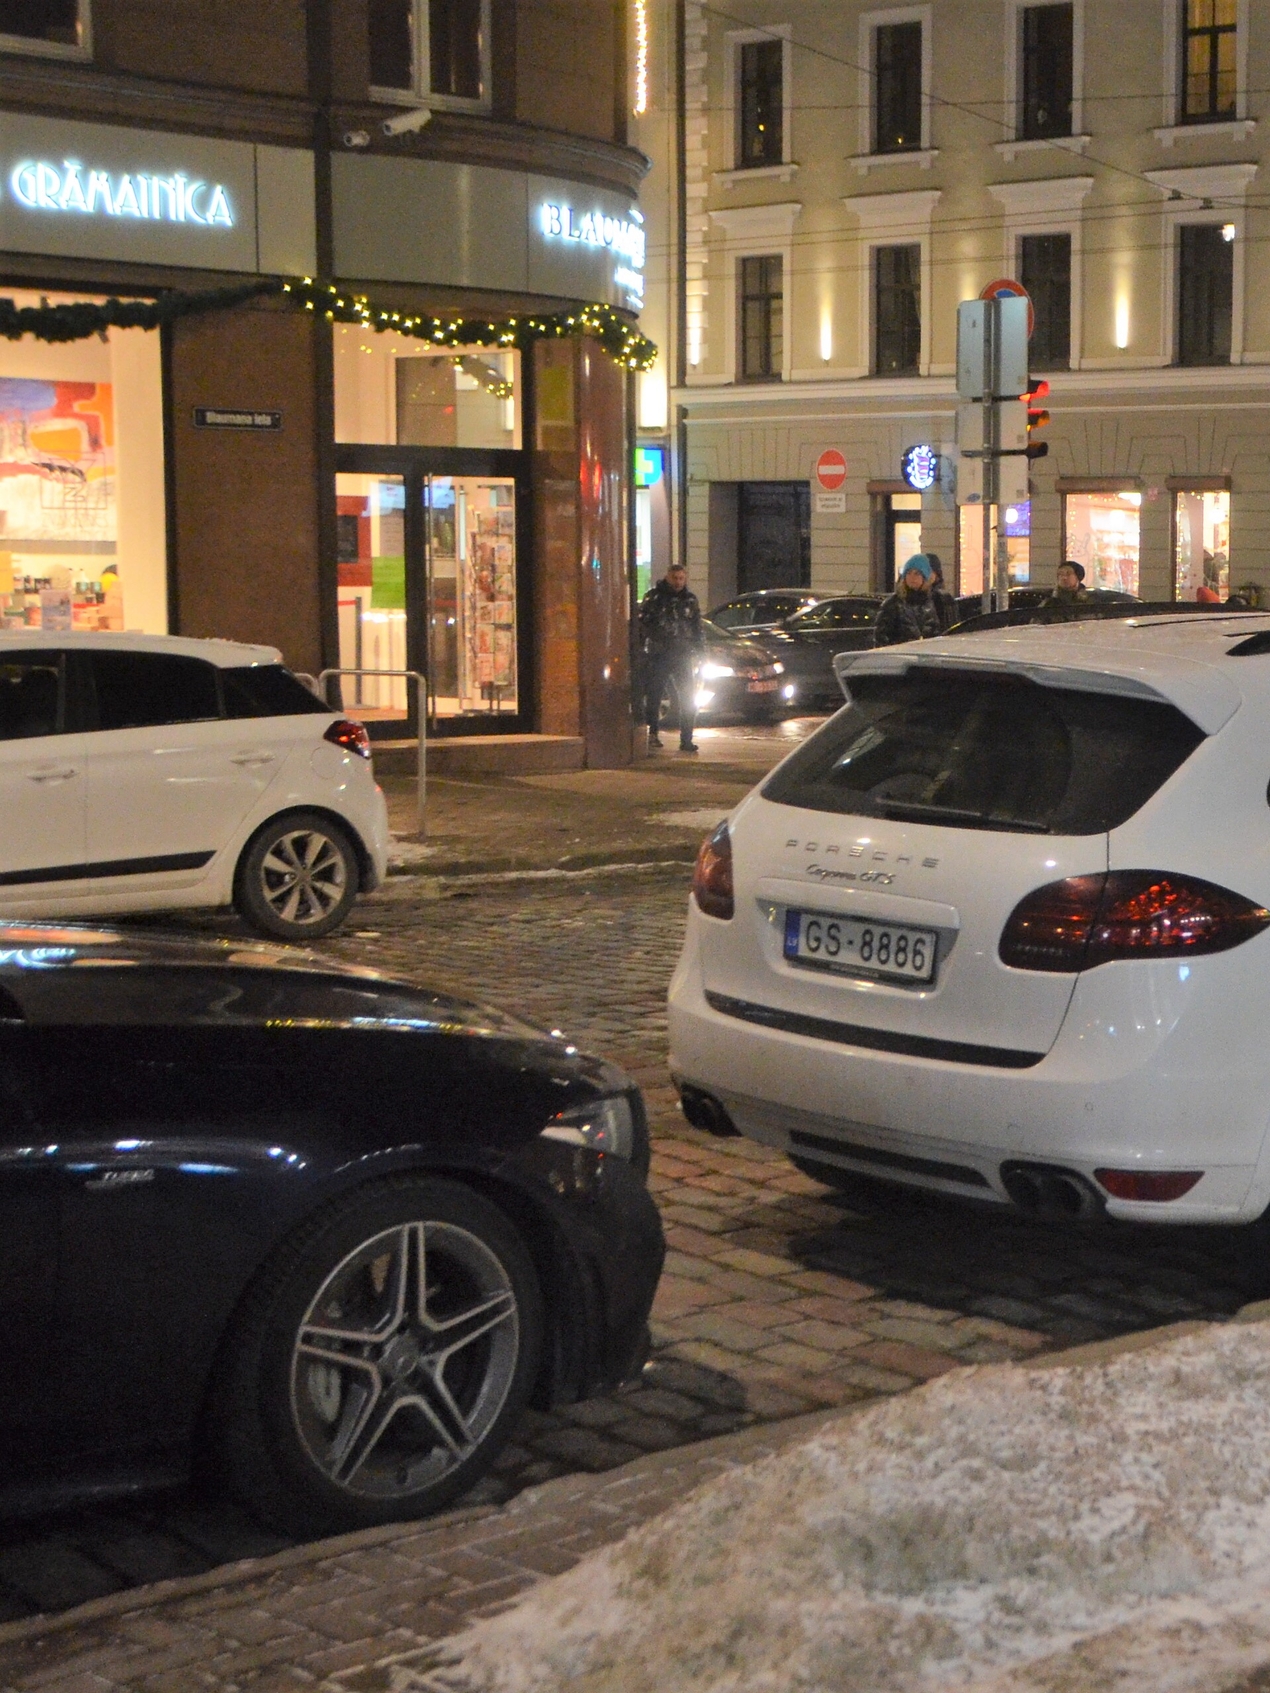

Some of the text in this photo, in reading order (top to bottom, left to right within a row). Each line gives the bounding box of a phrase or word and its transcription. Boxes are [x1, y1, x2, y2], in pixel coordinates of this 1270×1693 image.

[12, 160, 233, 226] GRĀMATNĪCA
[786, 839, 940, 869] PORSCHE
[859, 870, 896, 885] GTS
[805, 920, 926, 972] GS-8886
